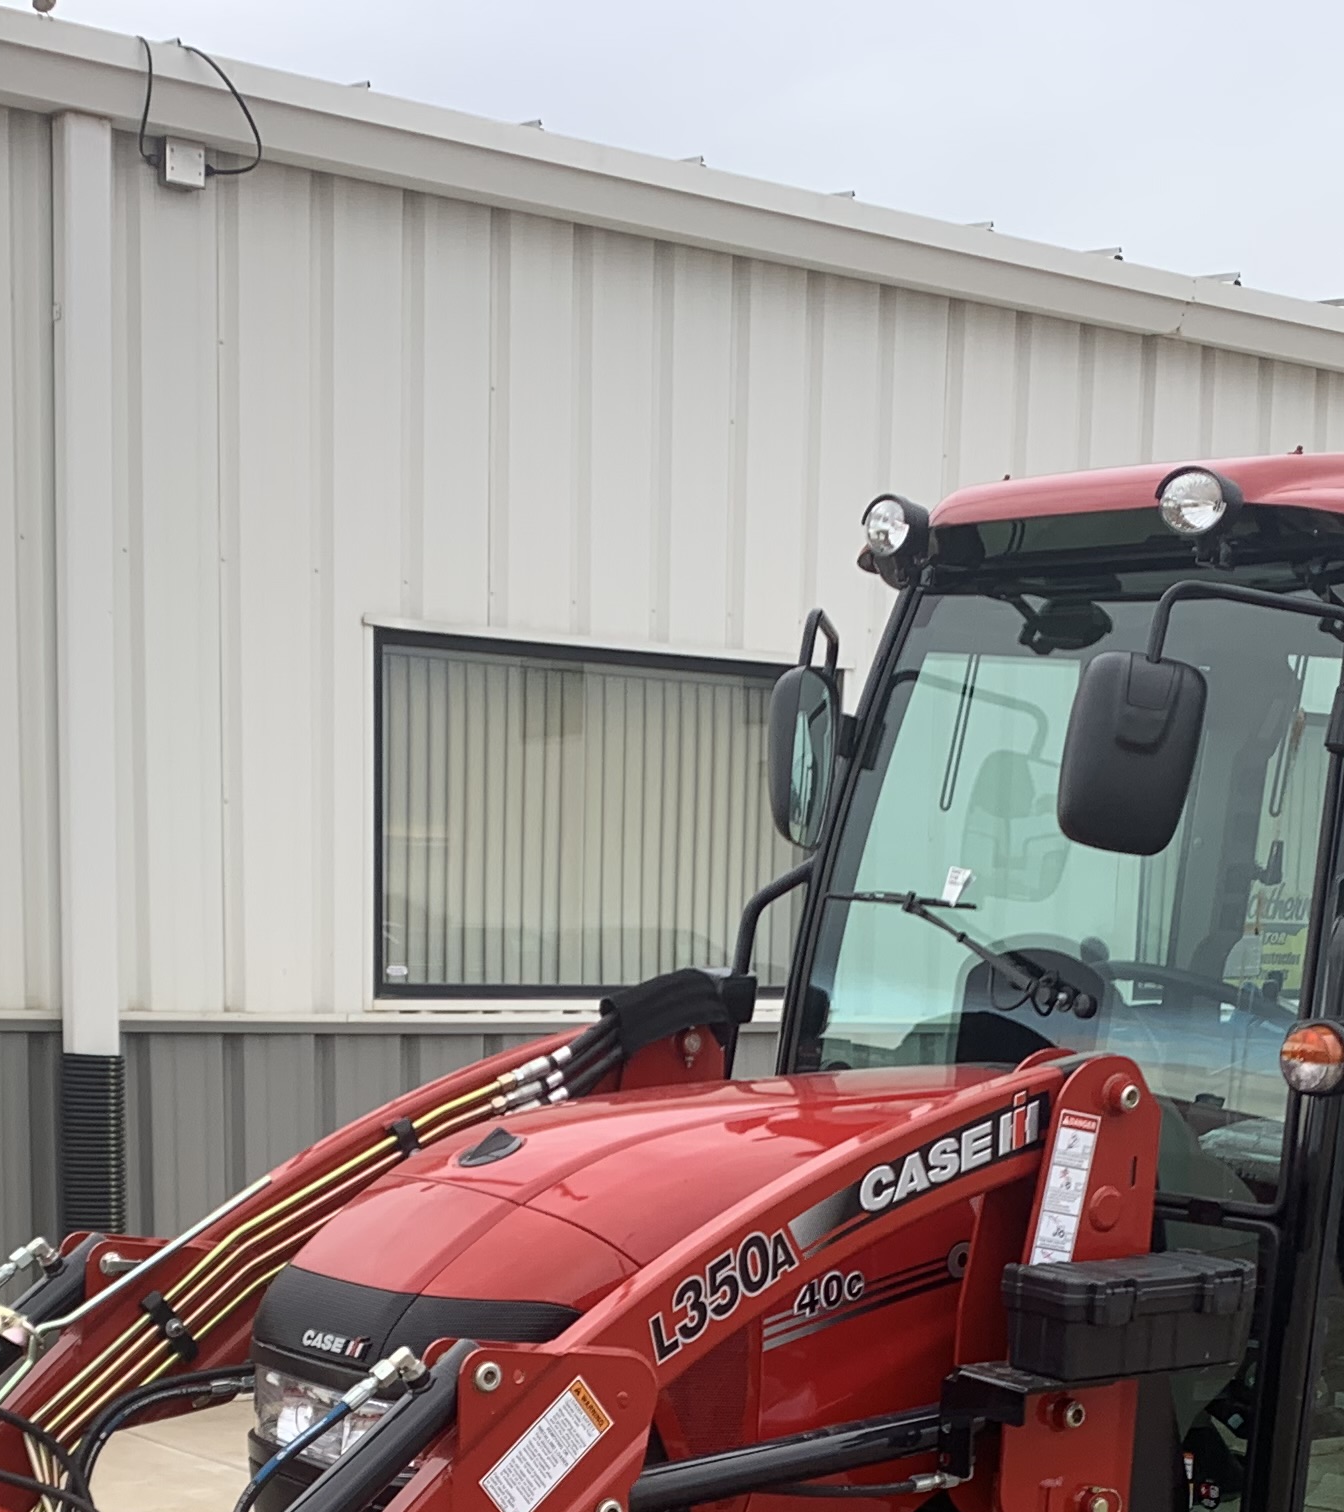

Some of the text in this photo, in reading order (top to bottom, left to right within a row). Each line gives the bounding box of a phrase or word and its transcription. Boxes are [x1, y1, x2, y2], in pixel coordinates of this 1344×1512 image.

[859, 1120, 993, 1212] CASE
[302, 1329, 347, 1354] CASE
[648, 1228, 799, 1366] L350A
